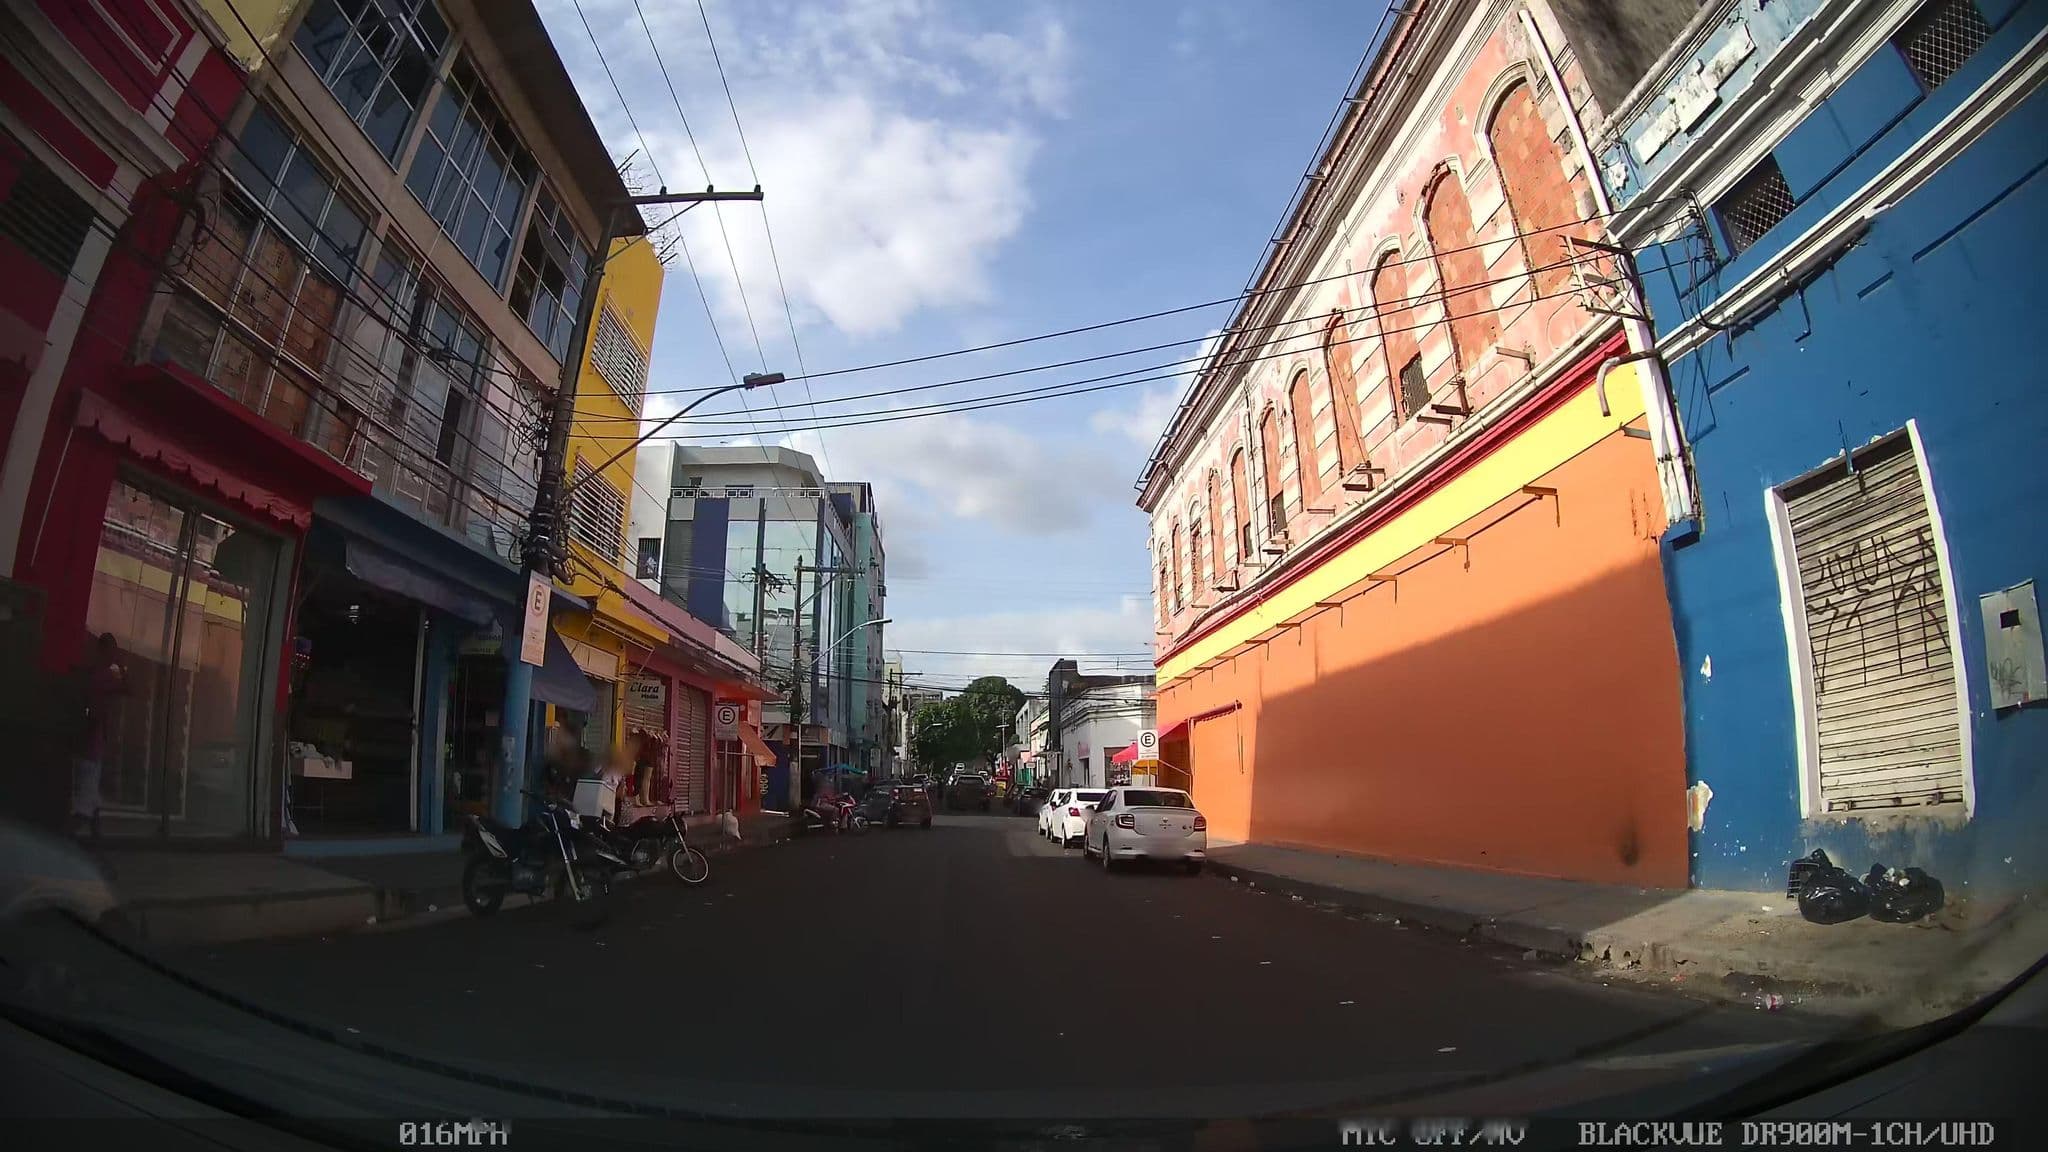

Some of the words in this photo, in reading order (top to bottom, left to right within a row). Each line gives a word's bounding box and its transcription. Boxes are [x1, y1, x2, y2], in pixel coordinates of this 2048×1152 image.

[534, 590, 542, 611] E
[630, 682, 660, 693] Clara
[722, 710, 731, 721] E
[1144, 735, 1152, 745] E
